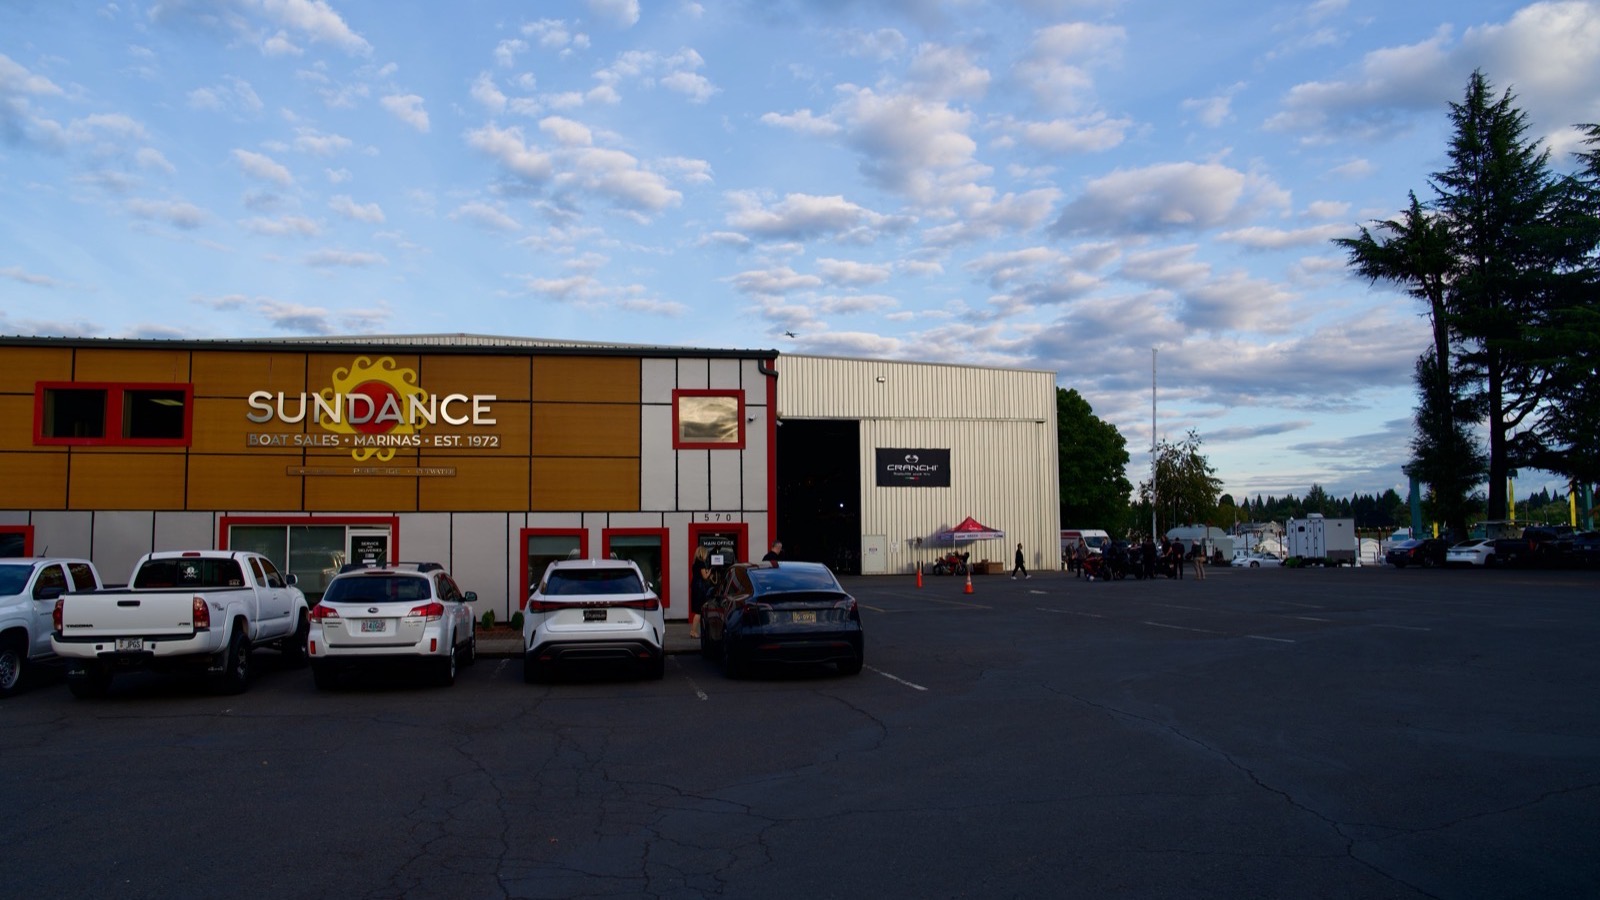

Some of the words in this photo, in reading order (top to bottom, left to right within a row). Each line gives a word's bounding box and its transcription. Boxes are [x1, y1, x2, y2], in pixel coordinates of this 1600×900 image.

[246, 390, 497, 425] SUNDANCE
[249, 433, 288, 446] BOAT
[294, 433, 340, 446] SALES
[354, 433, 422, 447] MARINAS
[434, 435, 463, 447] EST.
[467, 435, 499, 448] 1972
[887, 464, 937, 472] CRANCHI
[704, 513, 731, 521] 570
